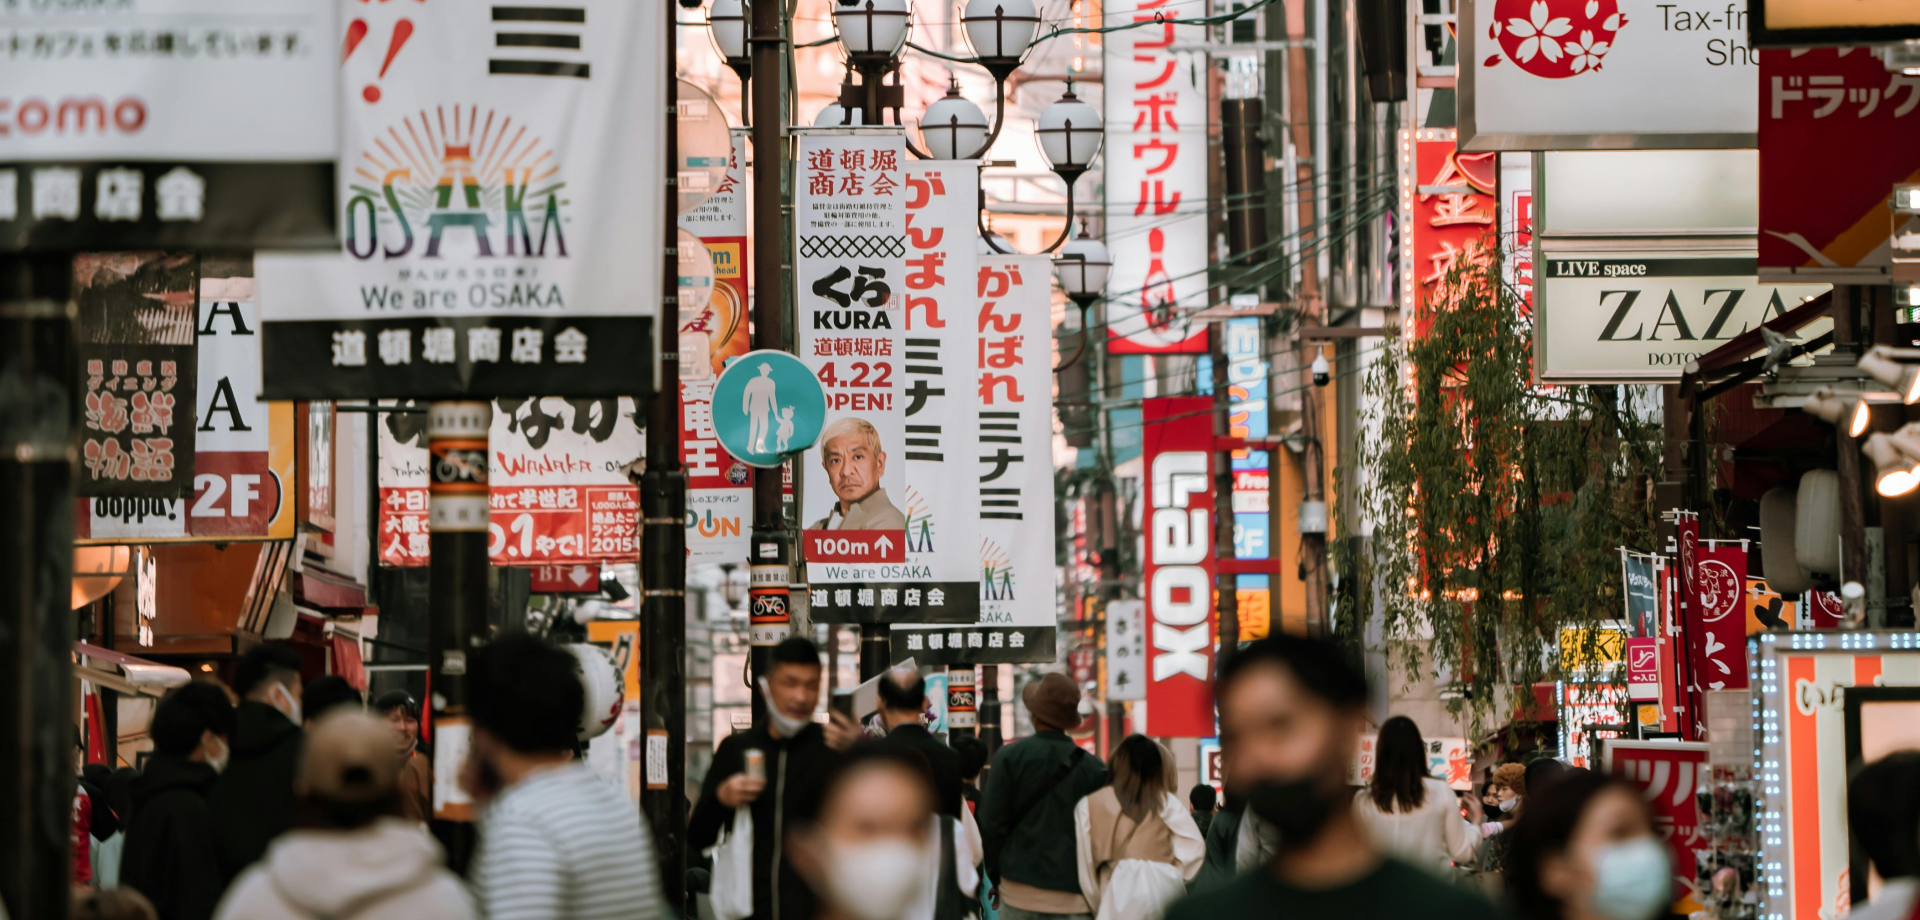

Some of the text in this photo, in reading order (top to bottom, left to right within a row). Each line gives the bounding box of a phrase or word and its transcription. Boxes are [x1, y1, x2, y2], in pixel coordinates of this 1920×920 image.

[1133, 0, 1181, 217] ゴンボウル
[807, 148, 899, 172] 道頓堀
[808, 171, 900, 197] 商店会
[1556, 261, 1647, 277] LIVE space
[361, 283, 565, 310] We are OSAKA
[811, 265, 892, 309] くら
[813, 310, 892, 330] KURA
[331, 326, 588, 367] 道頓堀商店会
[813, 337, 893, 357] 道頓堀店
[977, 266, 1025, 405] がんばれ
[817, 362, 893, 388] 4.22
[905, 338, 946, 462] ミナミ
[83, 437, 175, 481] 物語
[978, 410, 1025, 521] ミナミ
[190, 473, 261, 518] 2F
[814, 537, 869, 555] 100m
[826, 566, 932, 580] We are OSAKA
[811, 587, 945, 608] 道頓堀商店会
[906, 631, 1025, 651] 道頓堀商店会
[1641, 673, 1657, 681] 入口
